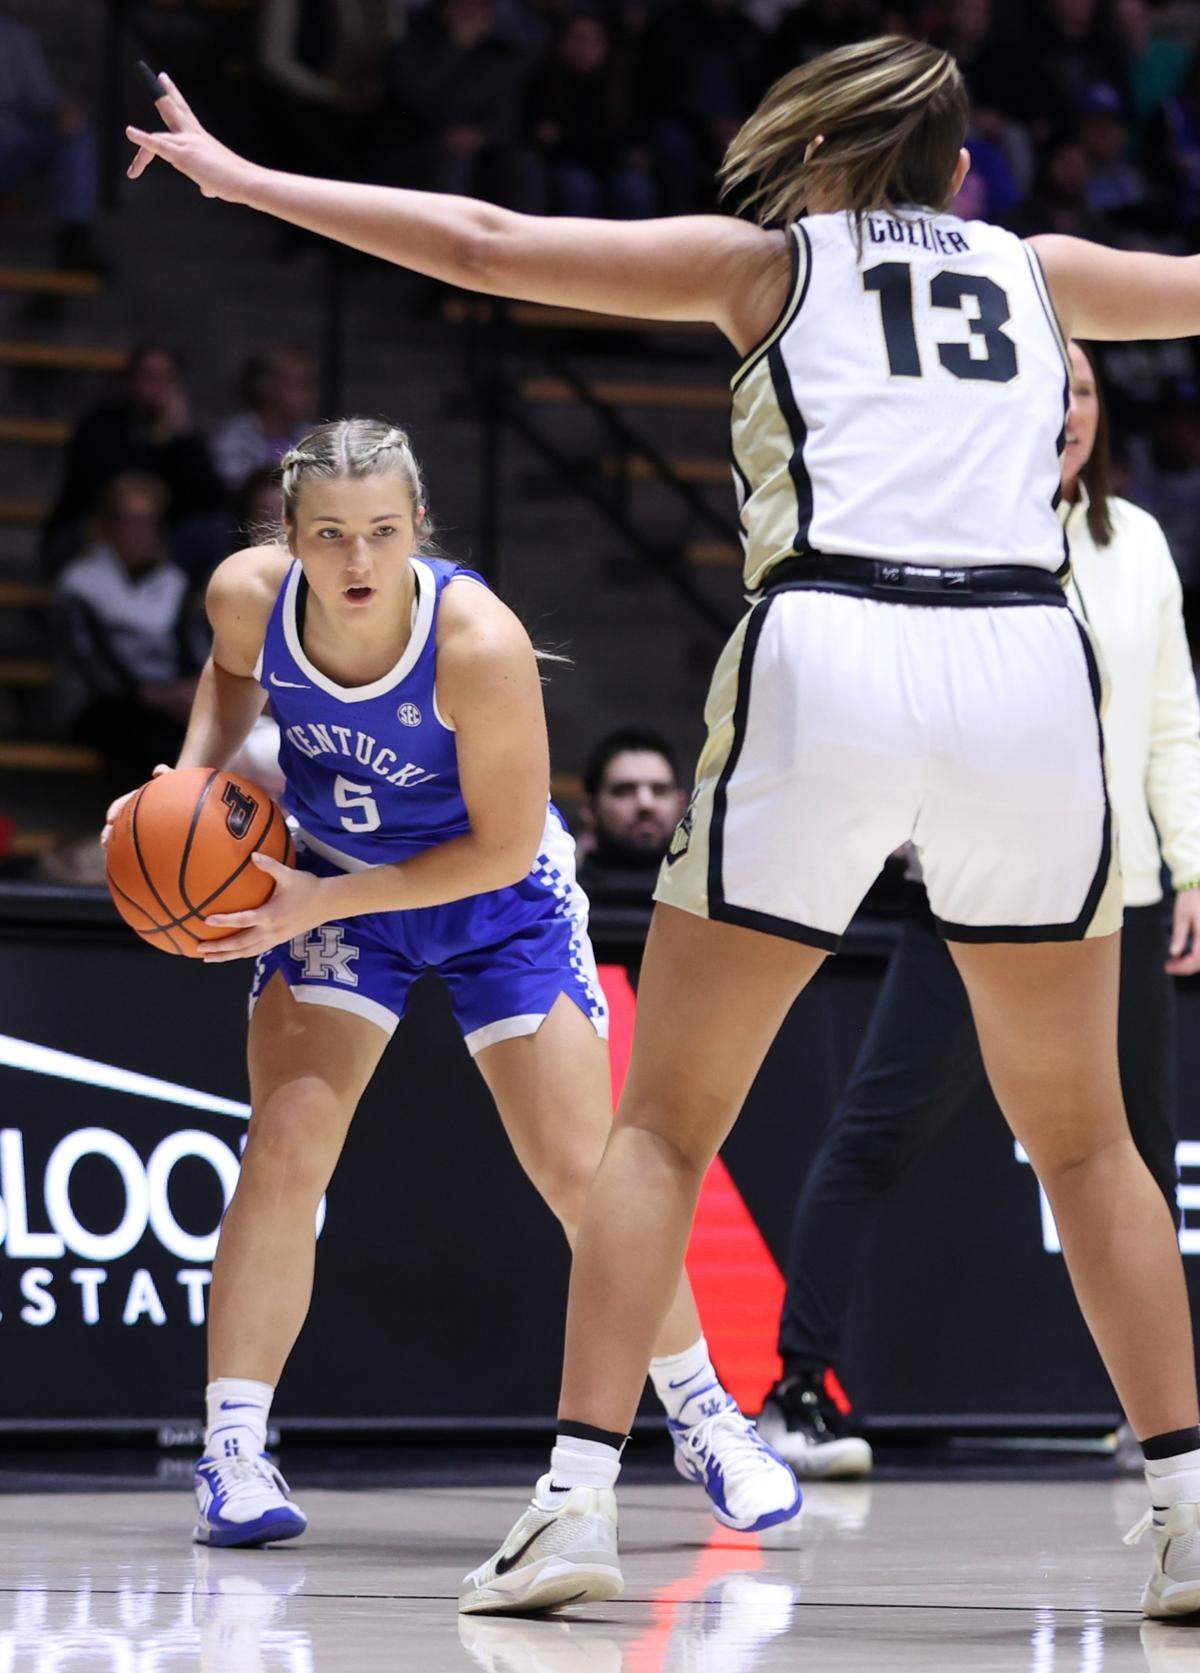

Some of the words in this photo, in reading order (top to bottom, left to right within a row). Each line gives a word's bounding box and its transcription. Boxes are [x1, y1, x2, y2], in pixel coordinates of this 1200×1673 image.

[867, 217, 971, 254] COLLIER
[862, 261, 1019, 383] 13
[399, 704, 420, 725] SEC
[221, 781, 259, 840] P
[333, 774, 381, 833] 5
[290, 925, 360, 987] UK
[0, 1126, 326, 1263] LOO
[0, 1267, 212, 1326] STAT
